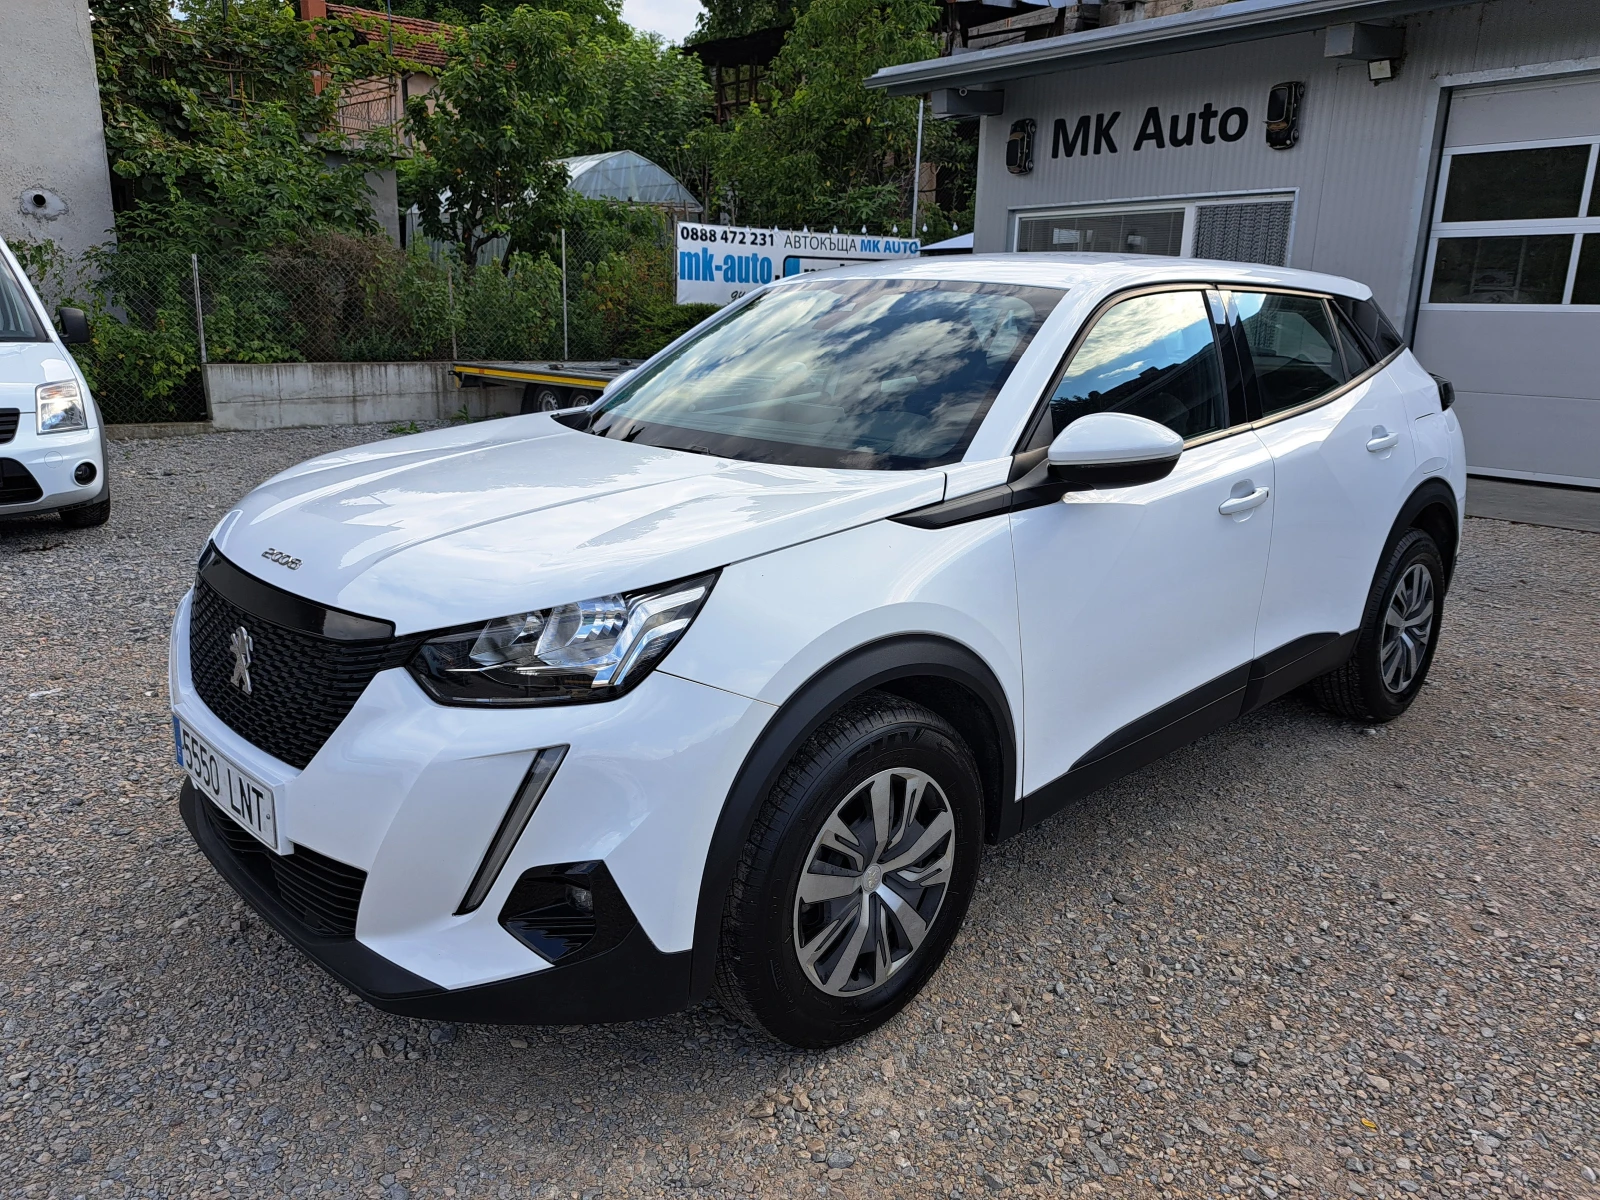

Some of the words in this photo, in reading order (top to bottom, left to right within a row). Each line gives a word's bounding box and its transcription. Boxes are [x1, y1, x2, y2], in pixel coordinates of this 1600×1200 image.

[1051, 111, 1122, 159] MK
[1133, 102, 1249, 151] Auto
[680, 226, 717, 243] 0888
[720, 230, 747, 245] 472
[750, 232, 774, 247] 231
[783, 234, 857, 254] АВТОКЪЩА
[860, 238, 881, 253] MK
[883, 239, 919, 254] AUTO
[261, 547, 304, 571] 2008
[182, 728, 220, 796] 5550
[227, 768, 264, 832] LNT
